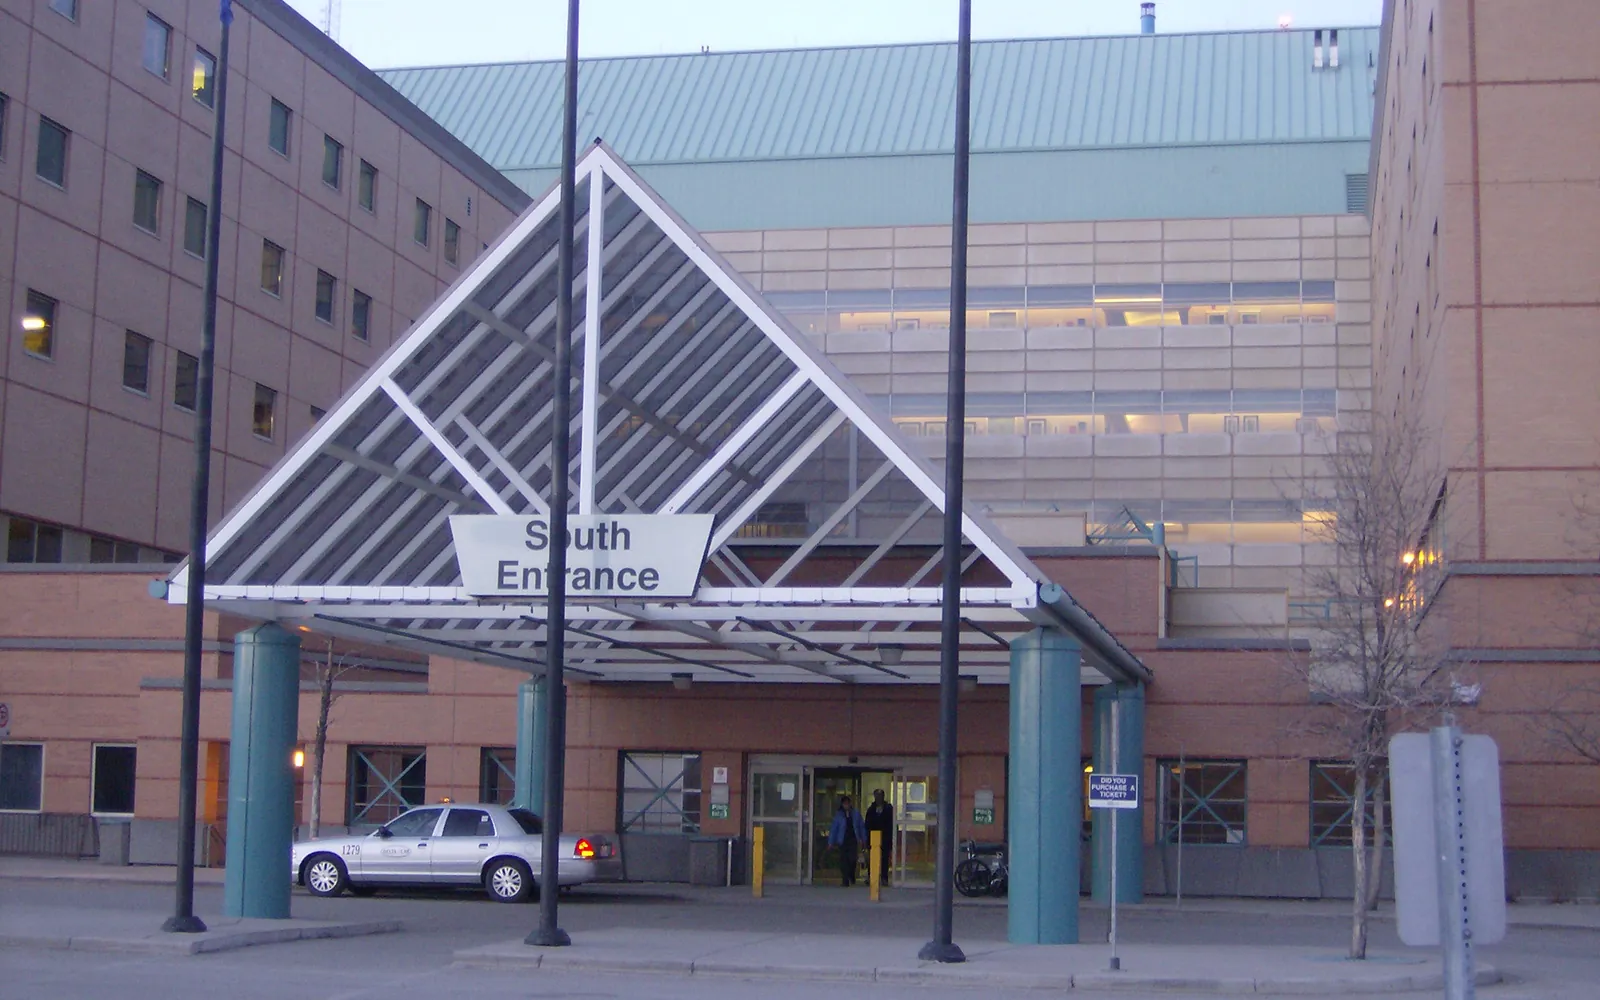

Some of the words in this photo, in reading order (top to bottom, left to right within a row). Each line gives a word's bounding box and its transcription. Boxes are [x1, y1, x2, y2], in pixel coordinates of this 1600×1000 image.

[525, 520, 630, 550] Suth
[497, 560, 660, 591] Enance
[342, 844, 360, 855] 1279
